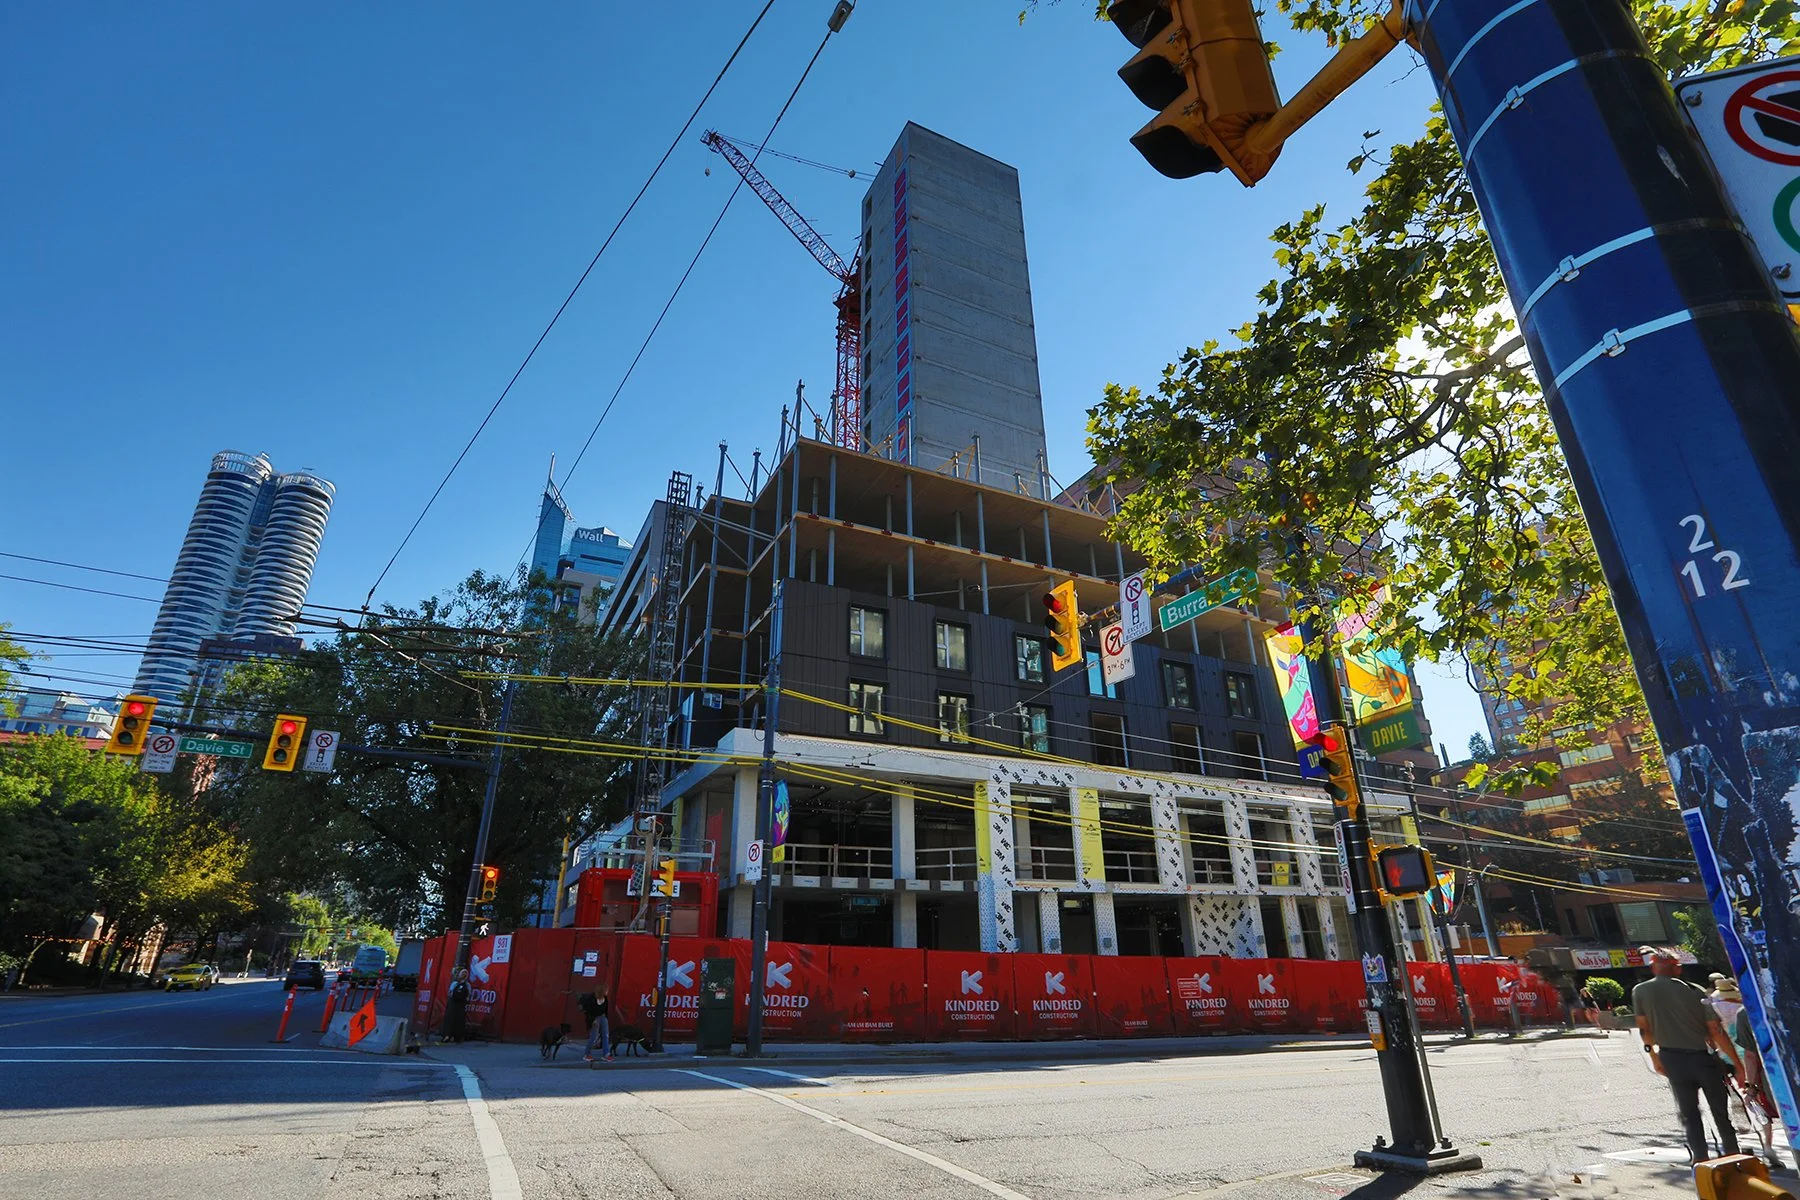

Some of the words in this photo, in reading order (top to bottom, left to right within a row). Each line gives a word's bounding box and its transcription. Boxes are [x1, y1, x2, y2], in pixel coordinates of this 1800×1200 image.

[578, 530, 604, 542] Wall
[1679, 514, 1714, 554] 2
[1681, 550, 1750, 597] 12
[1126, 626, 1148, 640] BICYCLES
[1127, 622, 1146, 634] EXCEPT
[1372, 721, 1408, 748] DAVIE
[186, 740, 223, 754] Davie
[230, 742, 244, 755] St
[1307, 749, 1325, 768] DAV
[945, 1000, 999, 1012] KINDRED
[1033, 1000, 1082, 1011] KINDRED
[1186, 998, 1227, 1009] KINDRED
[1248, 999, 1289, 1009] KINDRED
[646, 1010, 698, 1018] COSTRUCTIO
